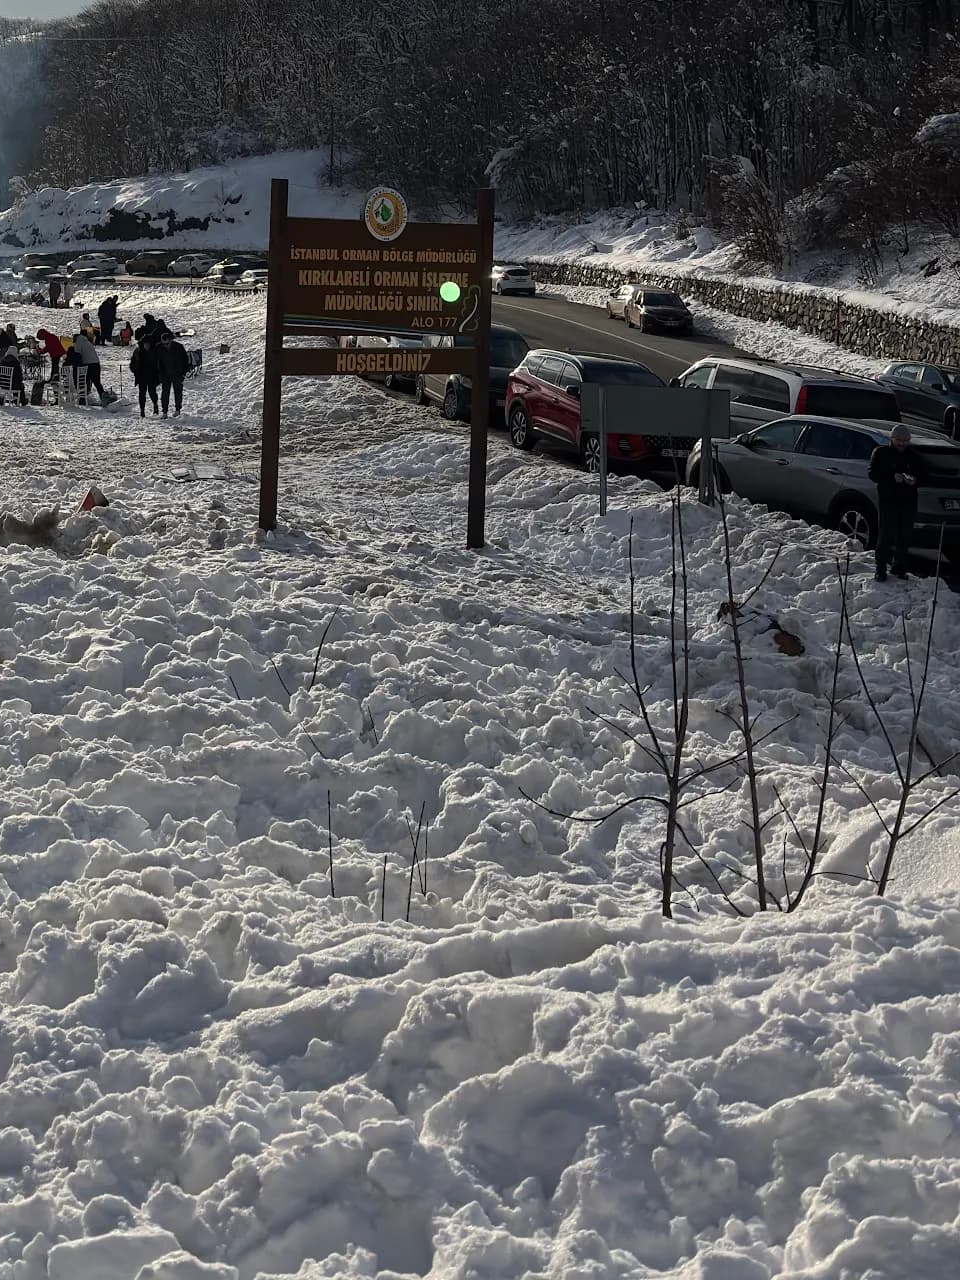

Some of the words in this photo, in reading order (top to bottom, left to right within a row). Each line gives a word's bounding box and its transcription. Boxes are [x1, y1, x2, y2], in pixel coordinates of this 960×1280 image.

[290, 245, 339, 261] İSTANBUL
[342, 249, 380, 262] ORMAN
[383, 248, 414, 263] BÖLGE
[416, 249, 477, 264] MÜDÜRLÜĞÜ
[298, 266, 370, 286] KIRKLARELİ
[373, 271, 419, 288] ORMAN
[325, 291, 403, 311] MÜDÜRLÜĞÜ
[411, 317, 434, 328] ALO
[440, 317, 458, 328] 177
